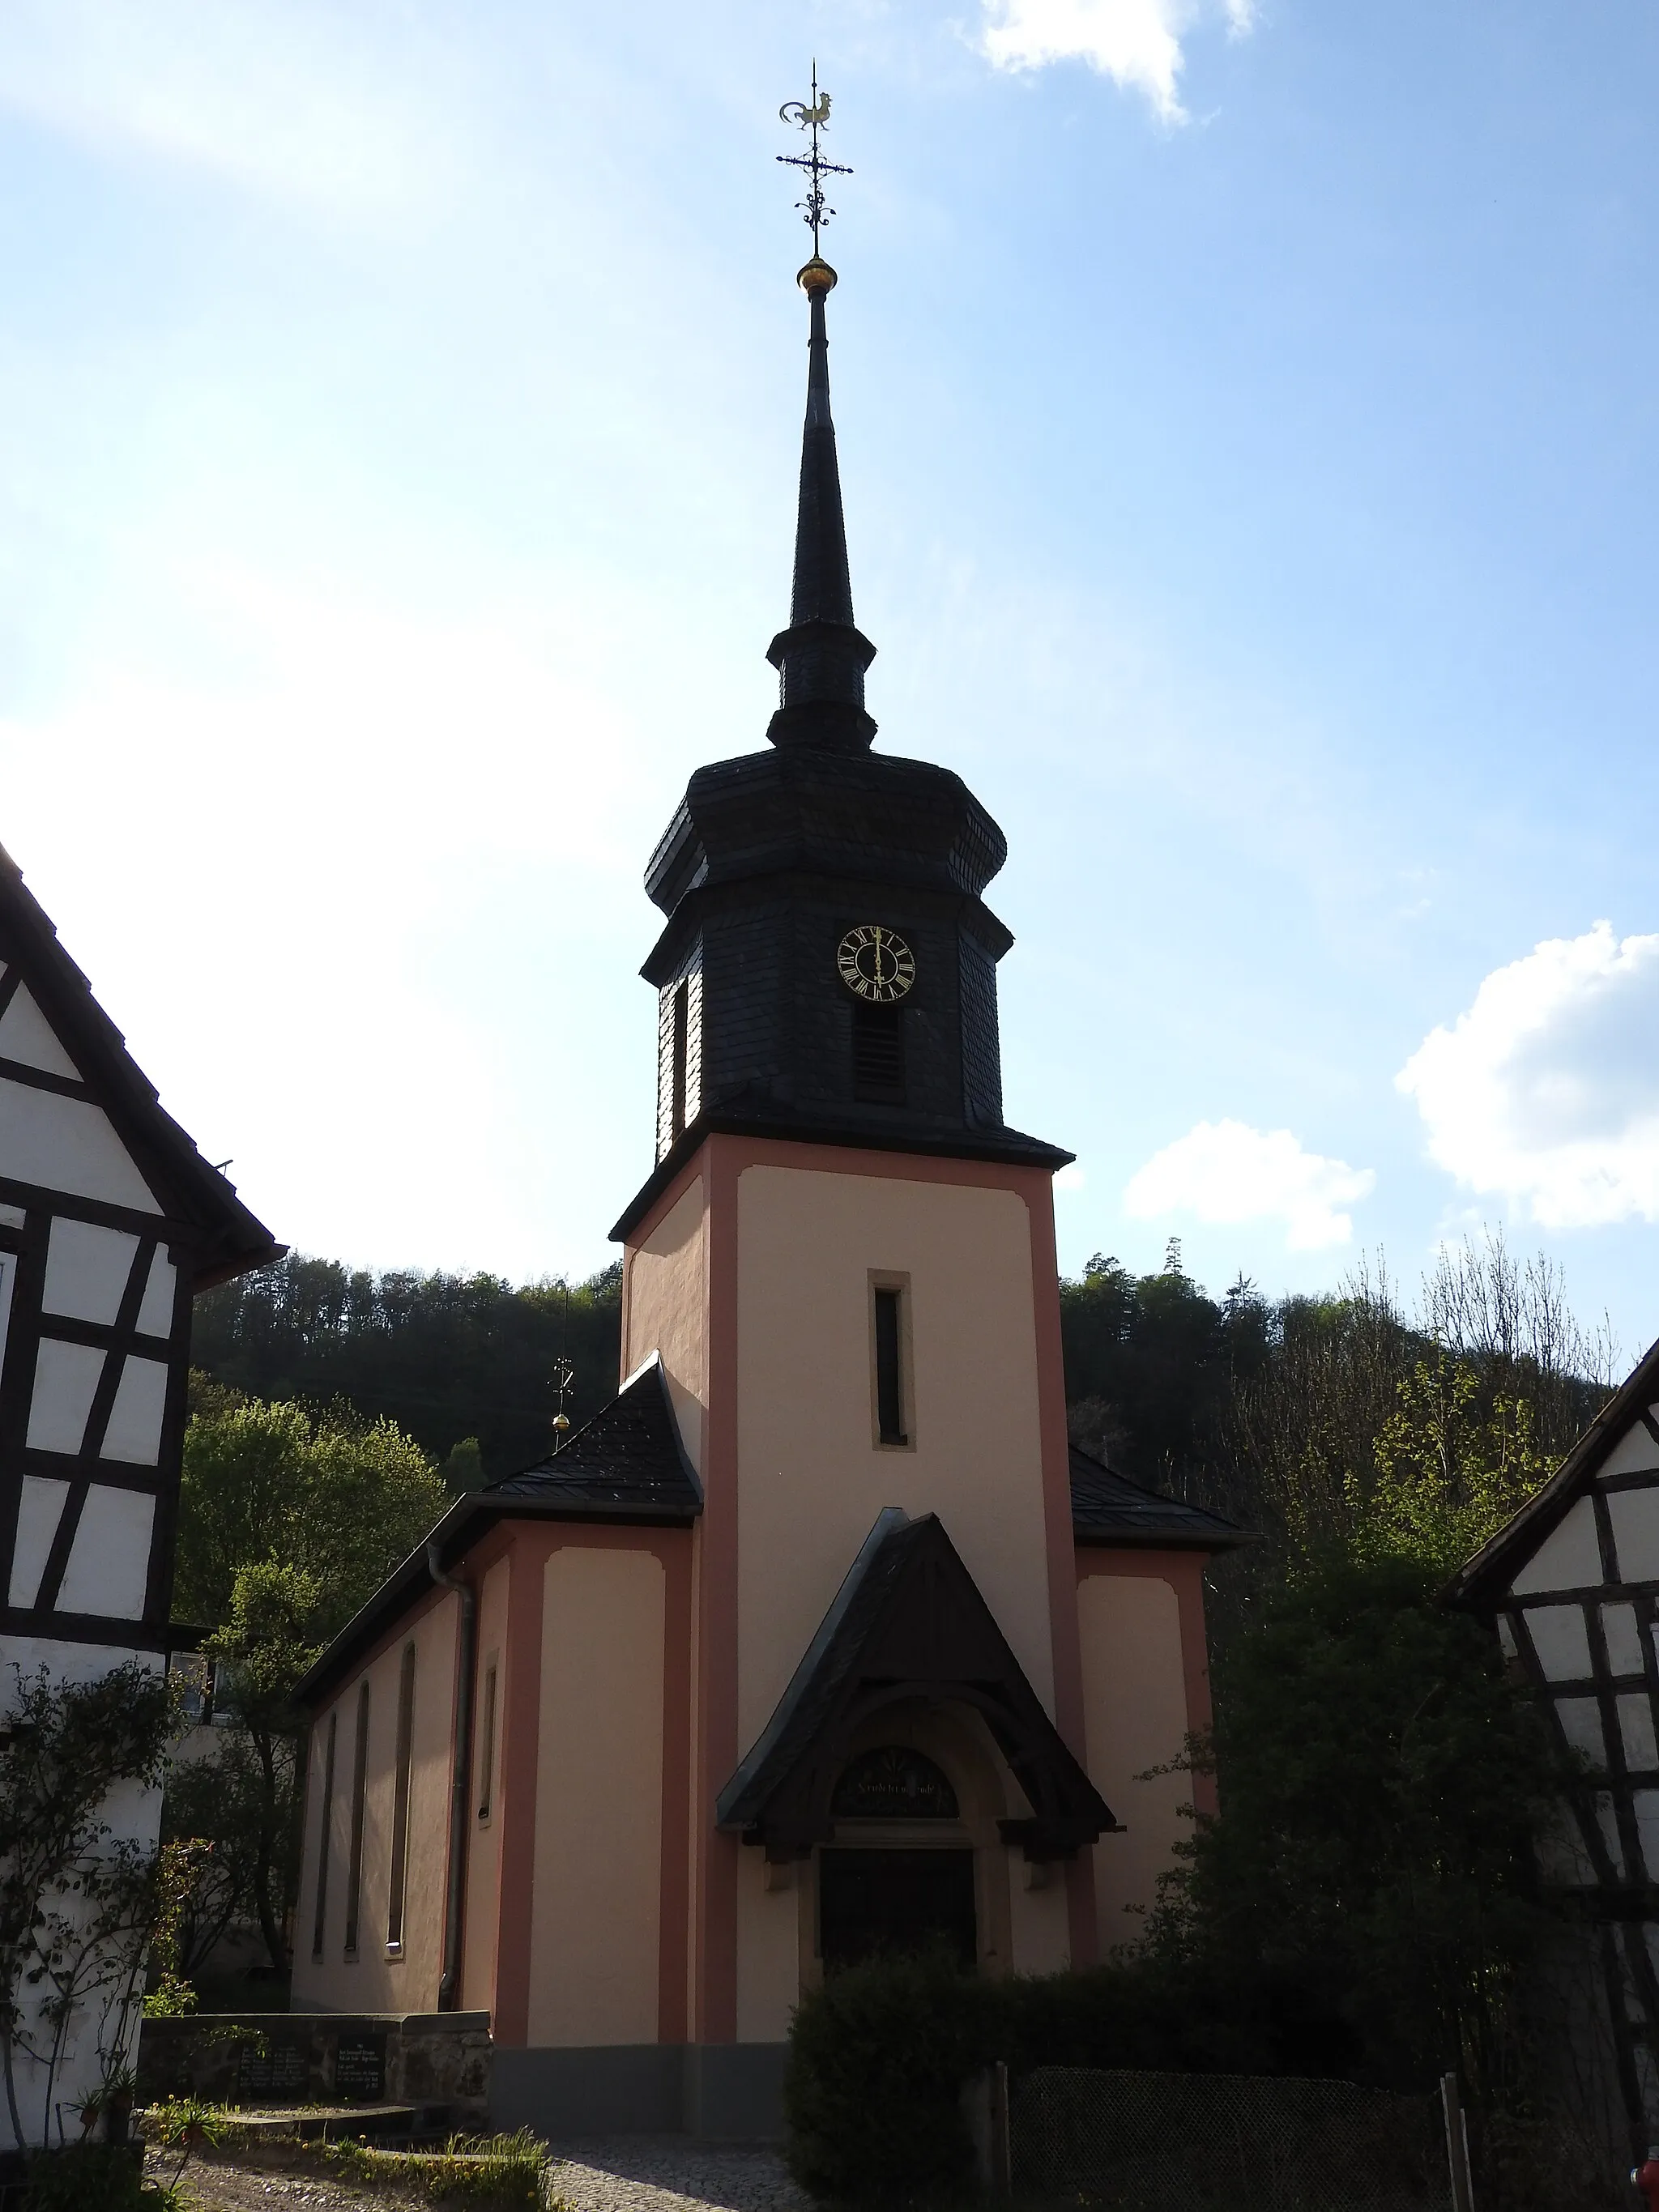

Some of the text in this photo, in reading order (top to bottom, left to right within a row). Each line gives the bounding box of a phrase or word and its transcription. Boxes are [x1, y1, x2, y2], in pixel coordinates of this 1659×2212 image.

[886, 933, 895, 946] I
[842, 940, 857, 953] X
[895, 948, 909, 957] II
[839, 955, 855, 965] IX
[898, 963, 914, 972] III
[842, 968, 860, 984] VIII
[855, 978, 869, 995] VII
[888, 984, 898, 999] V
